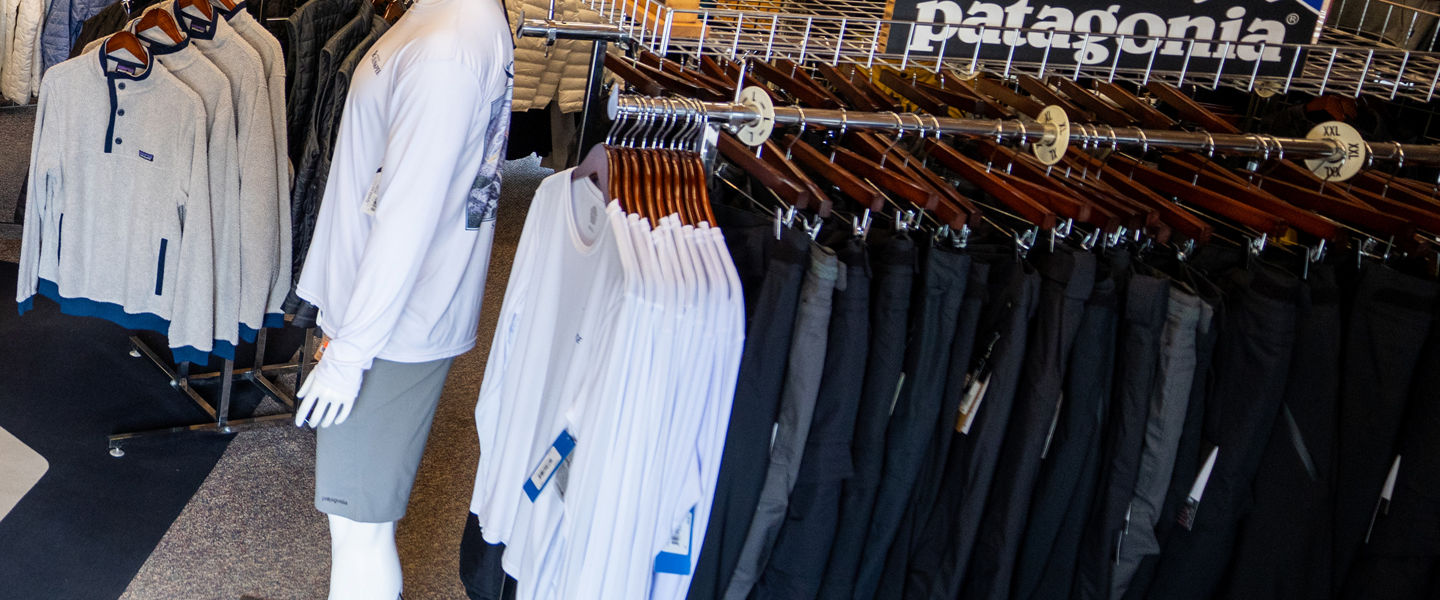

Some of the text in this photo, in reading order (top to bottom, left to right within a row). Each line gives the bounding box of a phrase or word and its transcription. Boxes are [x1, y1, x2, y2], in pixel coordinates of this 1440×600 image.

[909, 0, 1286, 65] patagonia
[1323, 125, 1341, 137] XXL
[1347, 143, 1360, 160] XXL
